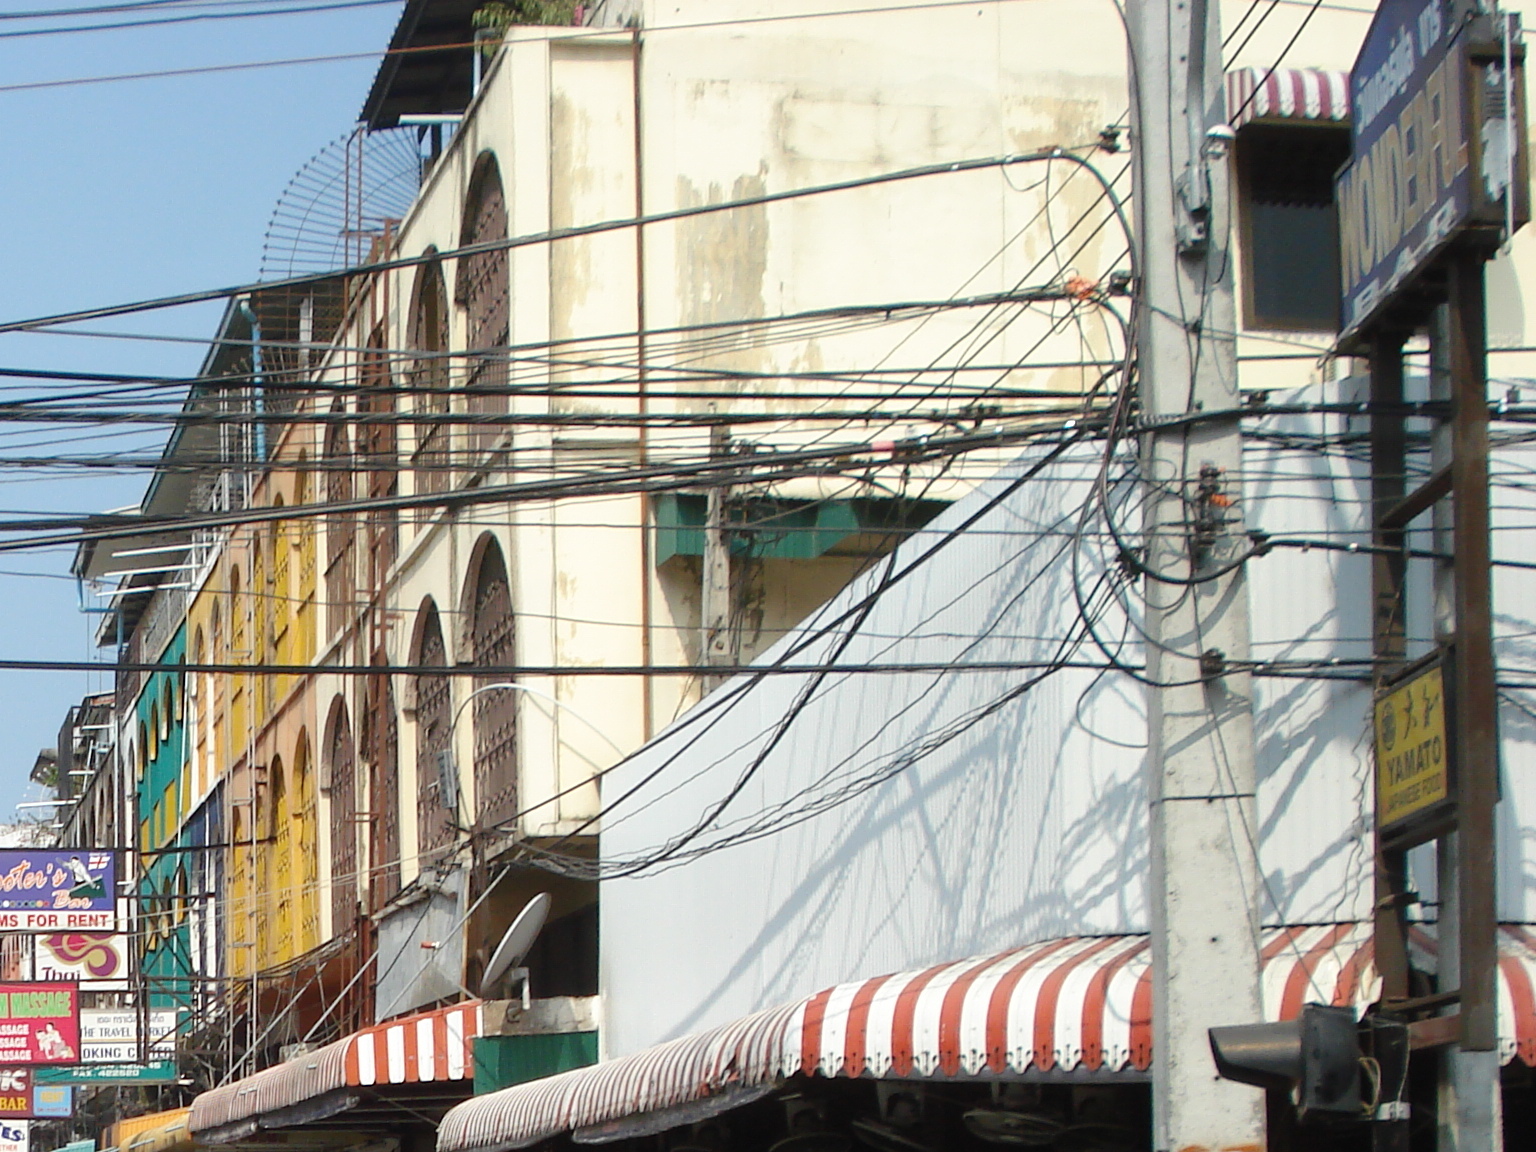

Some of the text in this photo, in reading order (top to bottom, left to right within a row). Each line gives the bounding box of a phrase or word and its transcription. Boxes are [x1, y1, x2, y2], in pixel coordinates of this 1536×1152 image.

[1387, 736, 1442, 788] YAMATO
[52, 889, 93, 910] Bar
[27, 914, 58, 928] FOR
[67, 914, 109, 928] RENT
[10, 991, 72, 1018] MASSAGE
[99, 1027, 132, 1038] TRAVEL
